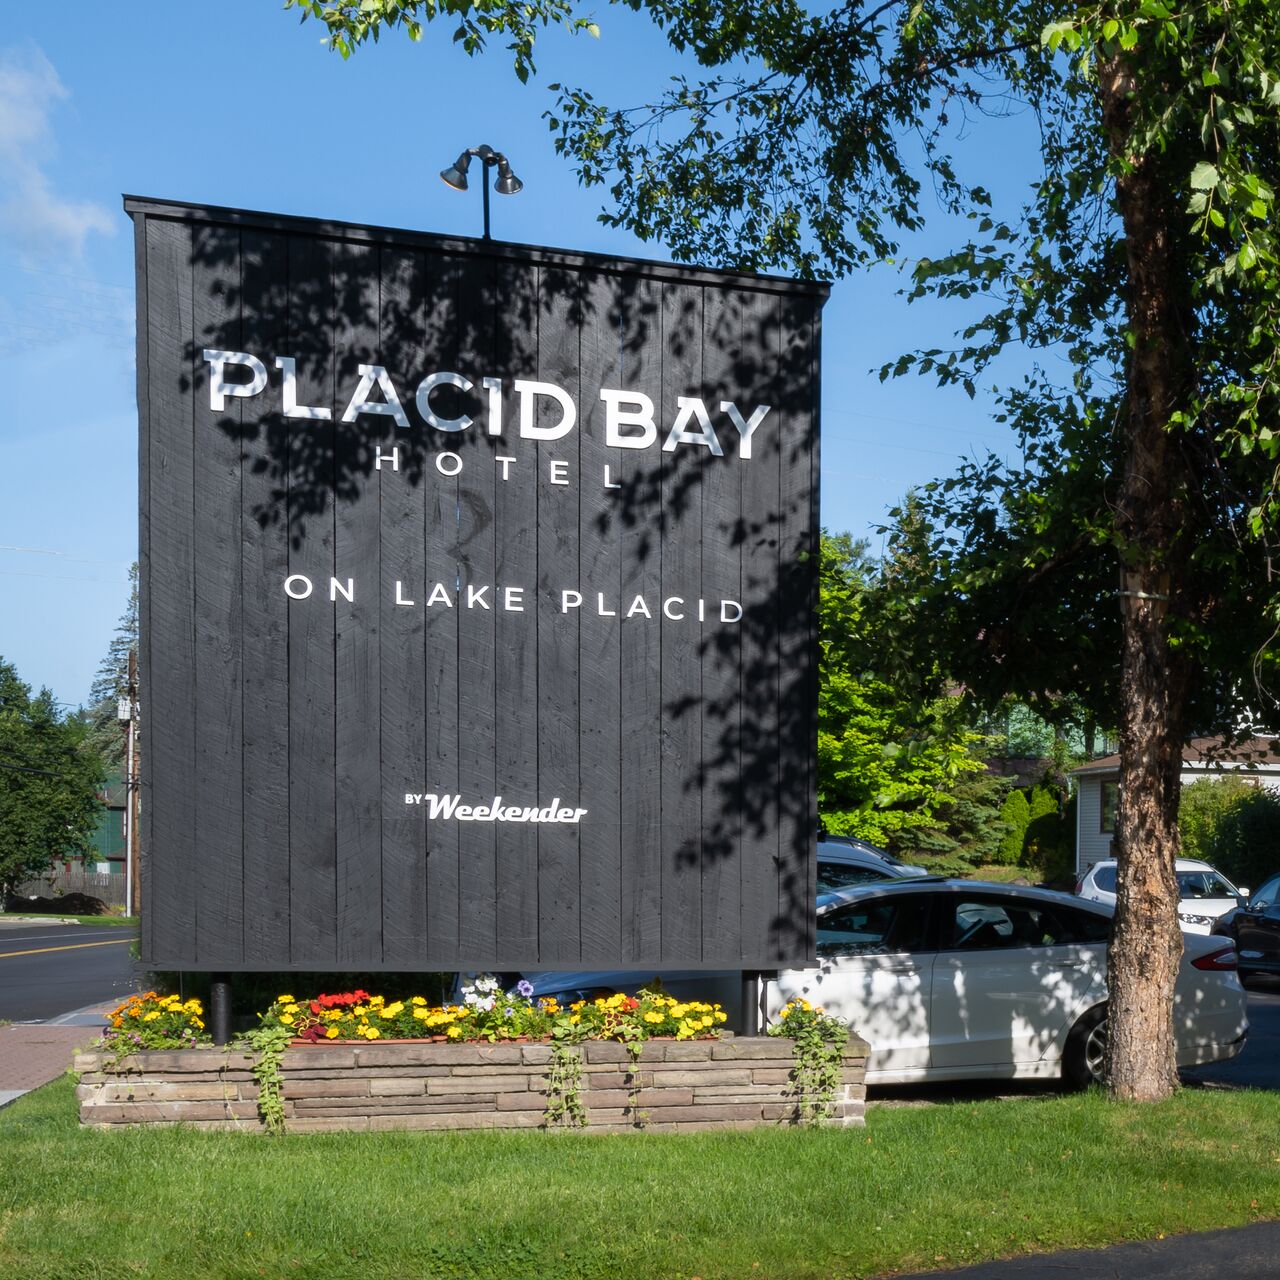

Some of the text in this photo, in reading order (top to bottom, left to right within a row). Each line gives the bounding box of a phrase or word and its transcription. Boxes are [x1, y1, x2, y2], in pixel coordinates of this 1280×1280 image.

[203, 349, 772, 460] PLACID BAY
[375, 445, 622, 490] HOTEL
[283, 573, 745, 624] ON LAKE PLACID
[405, 794, 588, 823] BY Weekender
